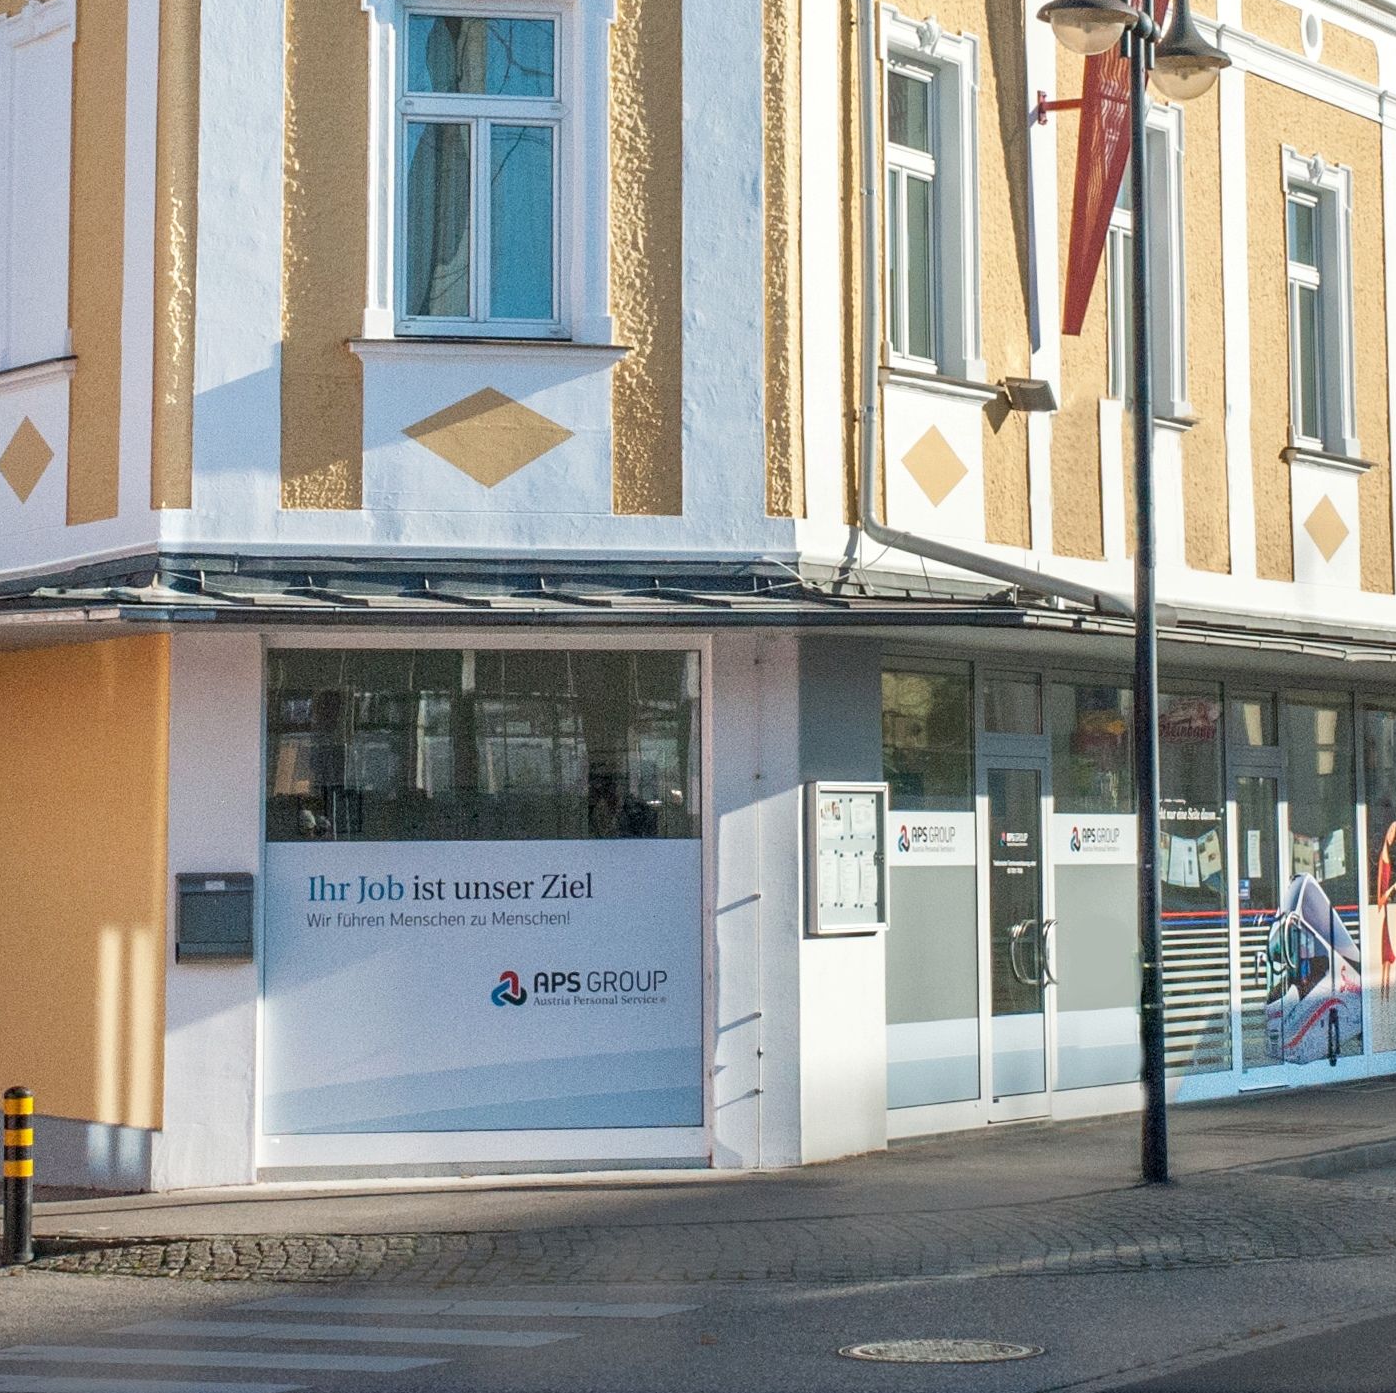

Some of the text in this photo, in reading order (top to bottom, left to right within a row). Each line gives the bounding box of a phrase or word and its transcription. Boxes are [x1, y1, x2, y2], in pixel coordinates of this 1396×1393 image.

[911, 826, 956, 843] APS GROUP
[308, 872, 594, 904] Ihr Job ist unser Ziel
[306, 910, 571, 928] Wir führen Menschen zu Menschen!
[533, 970, 668, 993] APS GROUP
[533, 995, 571, 1006] Austria
[573, 995, 618, 1005] Personal
